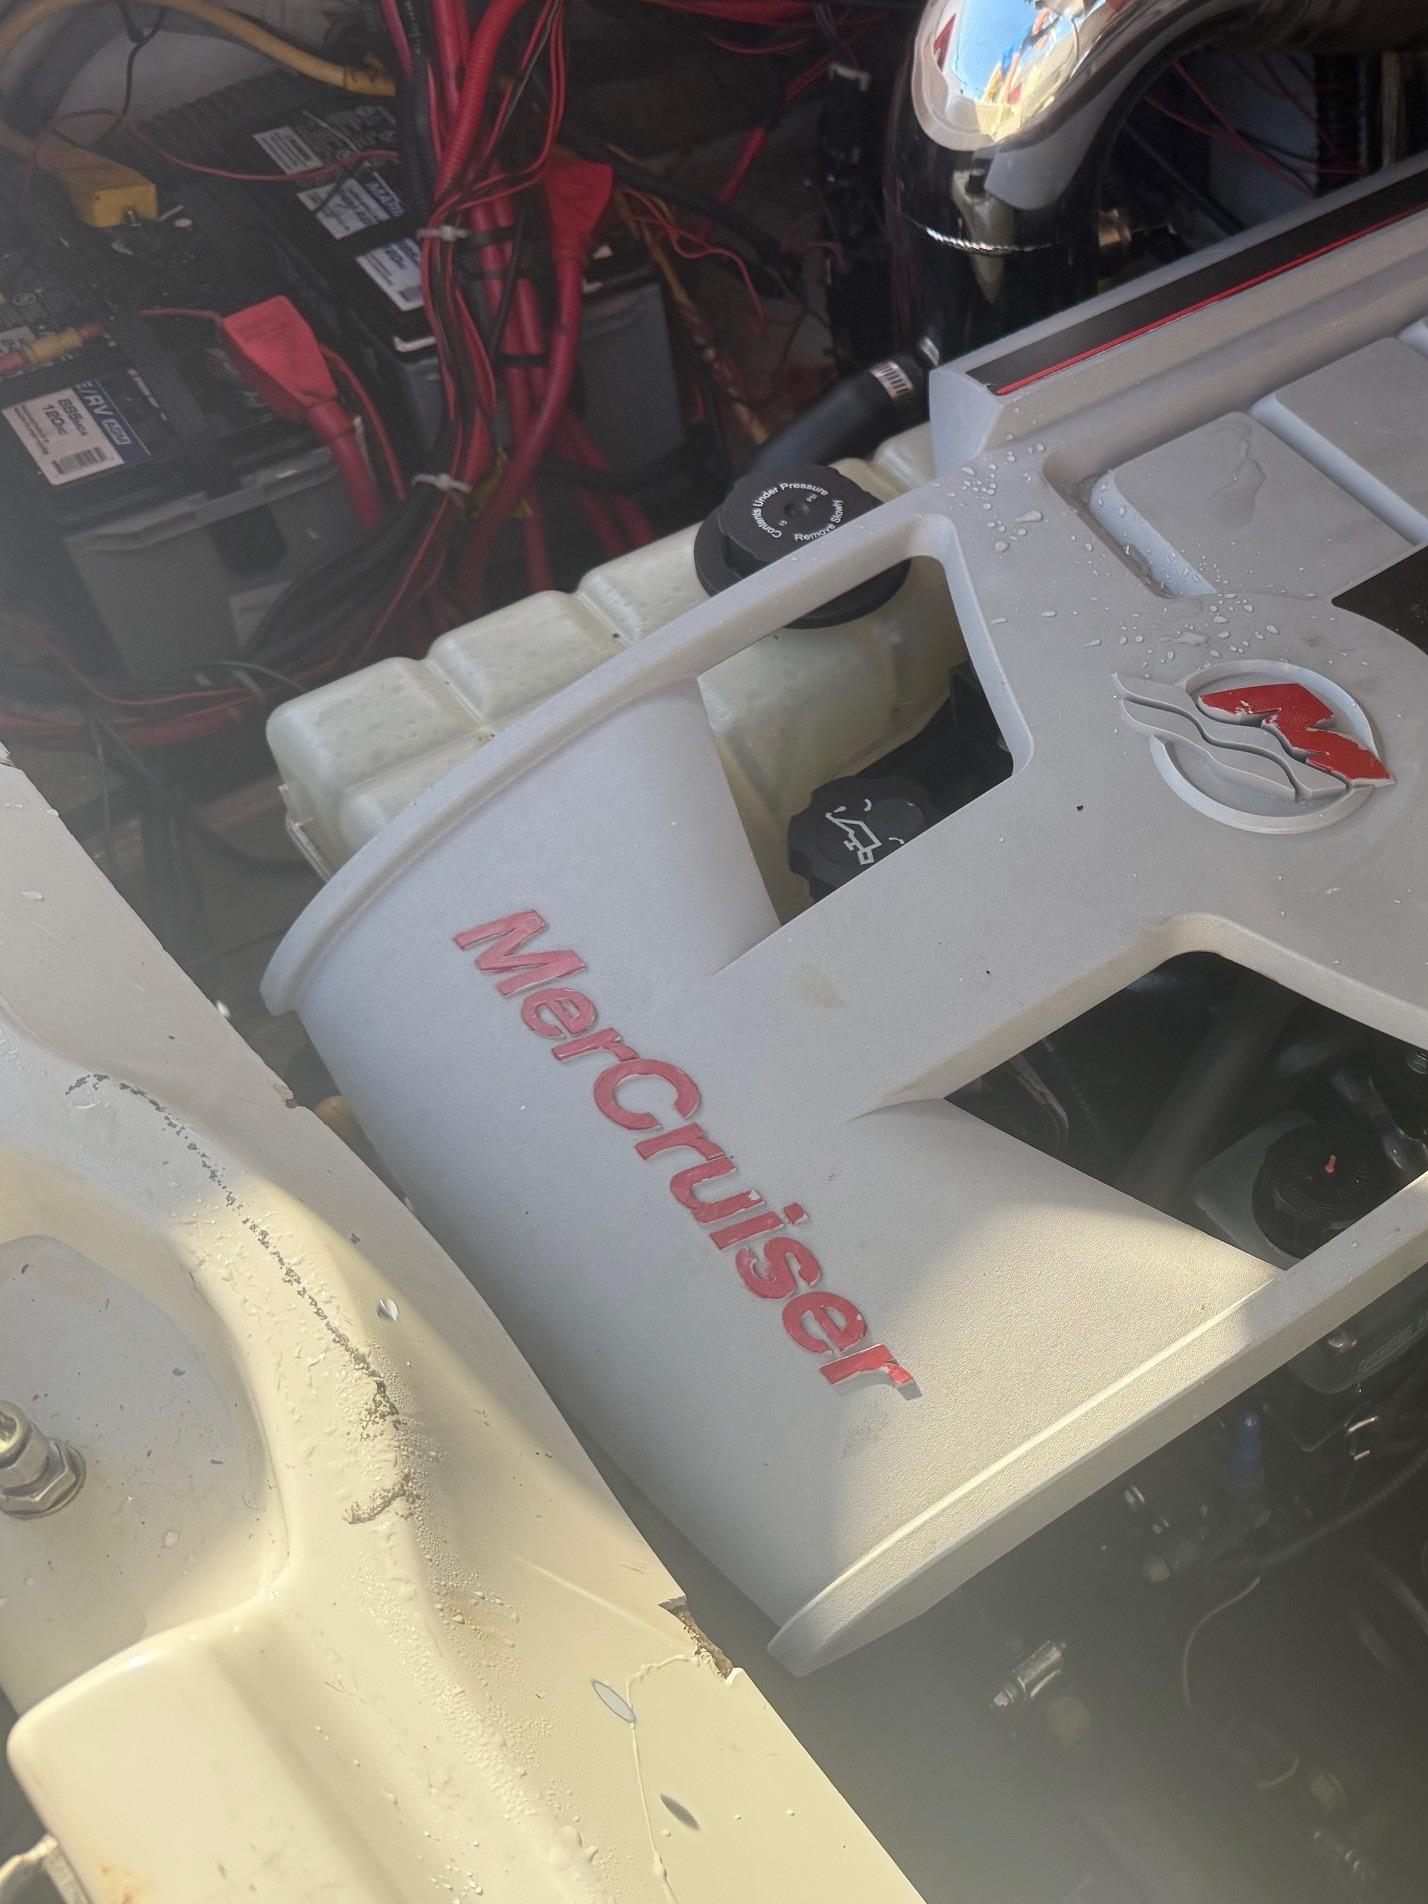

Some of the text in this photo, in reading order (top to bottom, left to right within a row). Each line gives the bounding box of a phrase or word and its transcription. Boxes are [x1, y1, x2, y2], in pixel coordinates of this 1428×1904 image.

[752, 482, 829, 539] Contents Under Pressure
[795, 500, 844, 541] Remove Slowly
[452, 908, 914, 1386] MerCruiser
